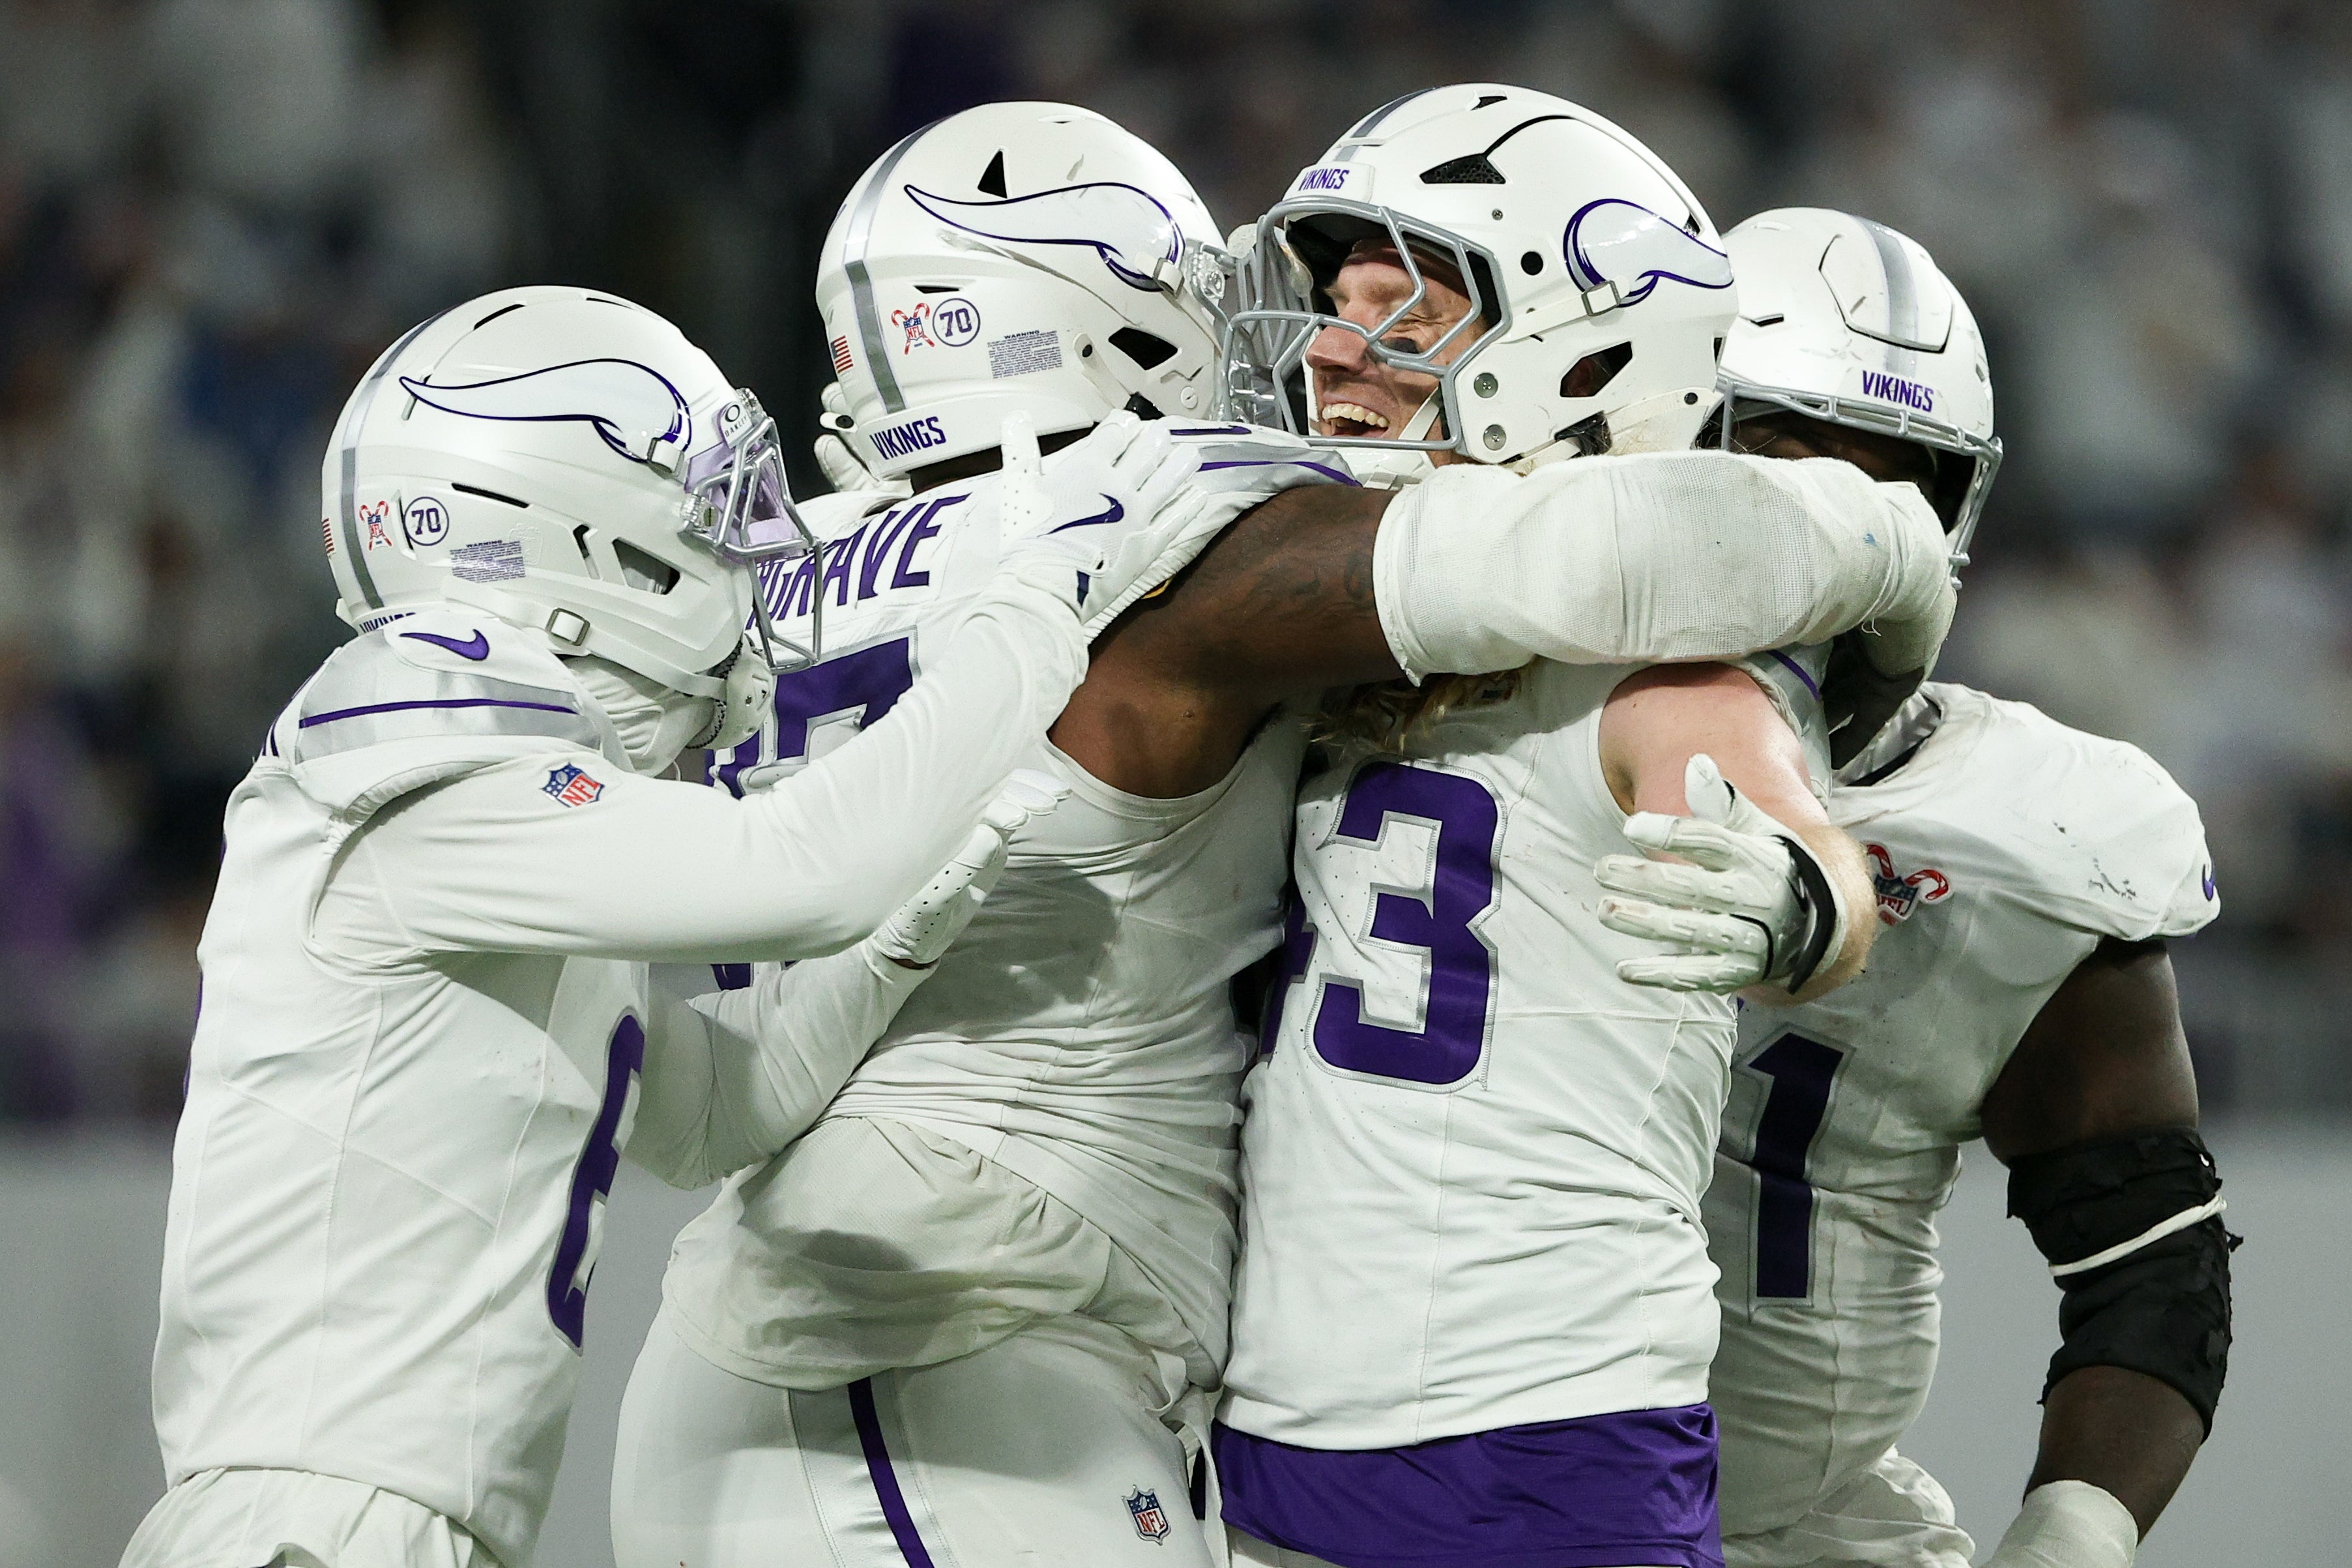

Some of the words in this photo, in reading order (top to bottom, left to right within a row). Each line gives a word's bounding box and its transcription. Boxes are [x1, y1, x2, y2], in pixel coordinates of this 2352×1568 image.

[1298, 168, 1350, 191] VIKINGS
[907, 326, 923, 338] NFL
[939, 308, 972, 337] 70
[1004, 330, 1040, 339] WARNING
[1863, 370, 1934, 413] VIKINGS
[869, 416, 946, 460] VIKINGS
[411, 508, 441, 535] 70
[561, 774, 601, 807] NFL
[1137, 1510, 1165, 1533] NFL
